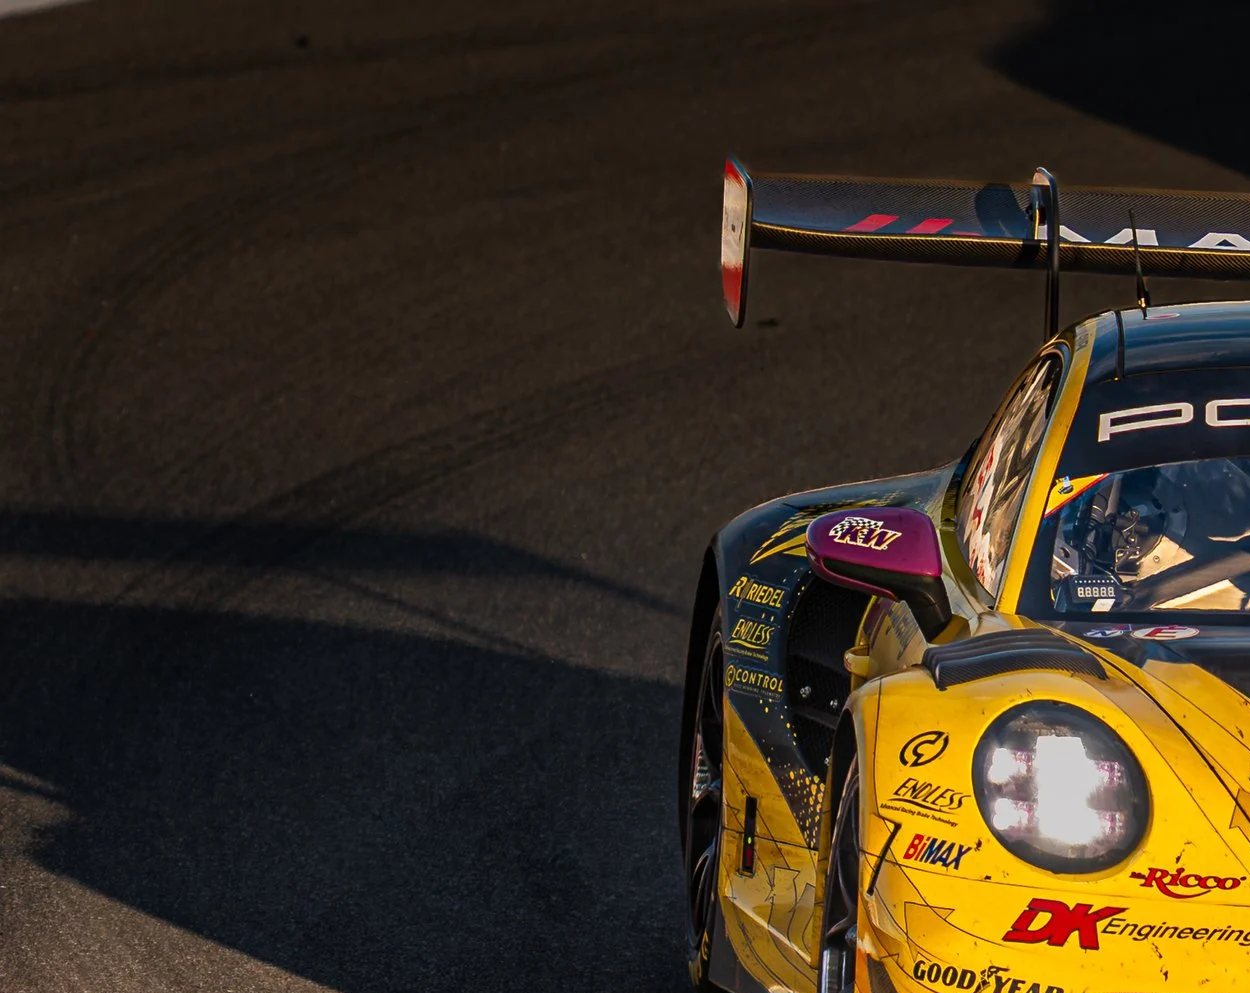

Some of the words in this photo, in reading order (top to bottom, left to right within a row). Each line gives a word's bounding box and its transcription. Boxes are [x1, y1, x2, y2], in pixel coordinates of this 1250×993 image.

[746, 583, 785, 608] RIEDEL
[732, 618, 775, 645] ENDLESS
[735, 669, 783, 692] CONTROL
[893, 777, 972, 810] ENDLESS
[903, 833, 972, 870] BiMAX
[1140, 867, 1241, 899] Ricco
[1002, 898, 1129, 950] DK
